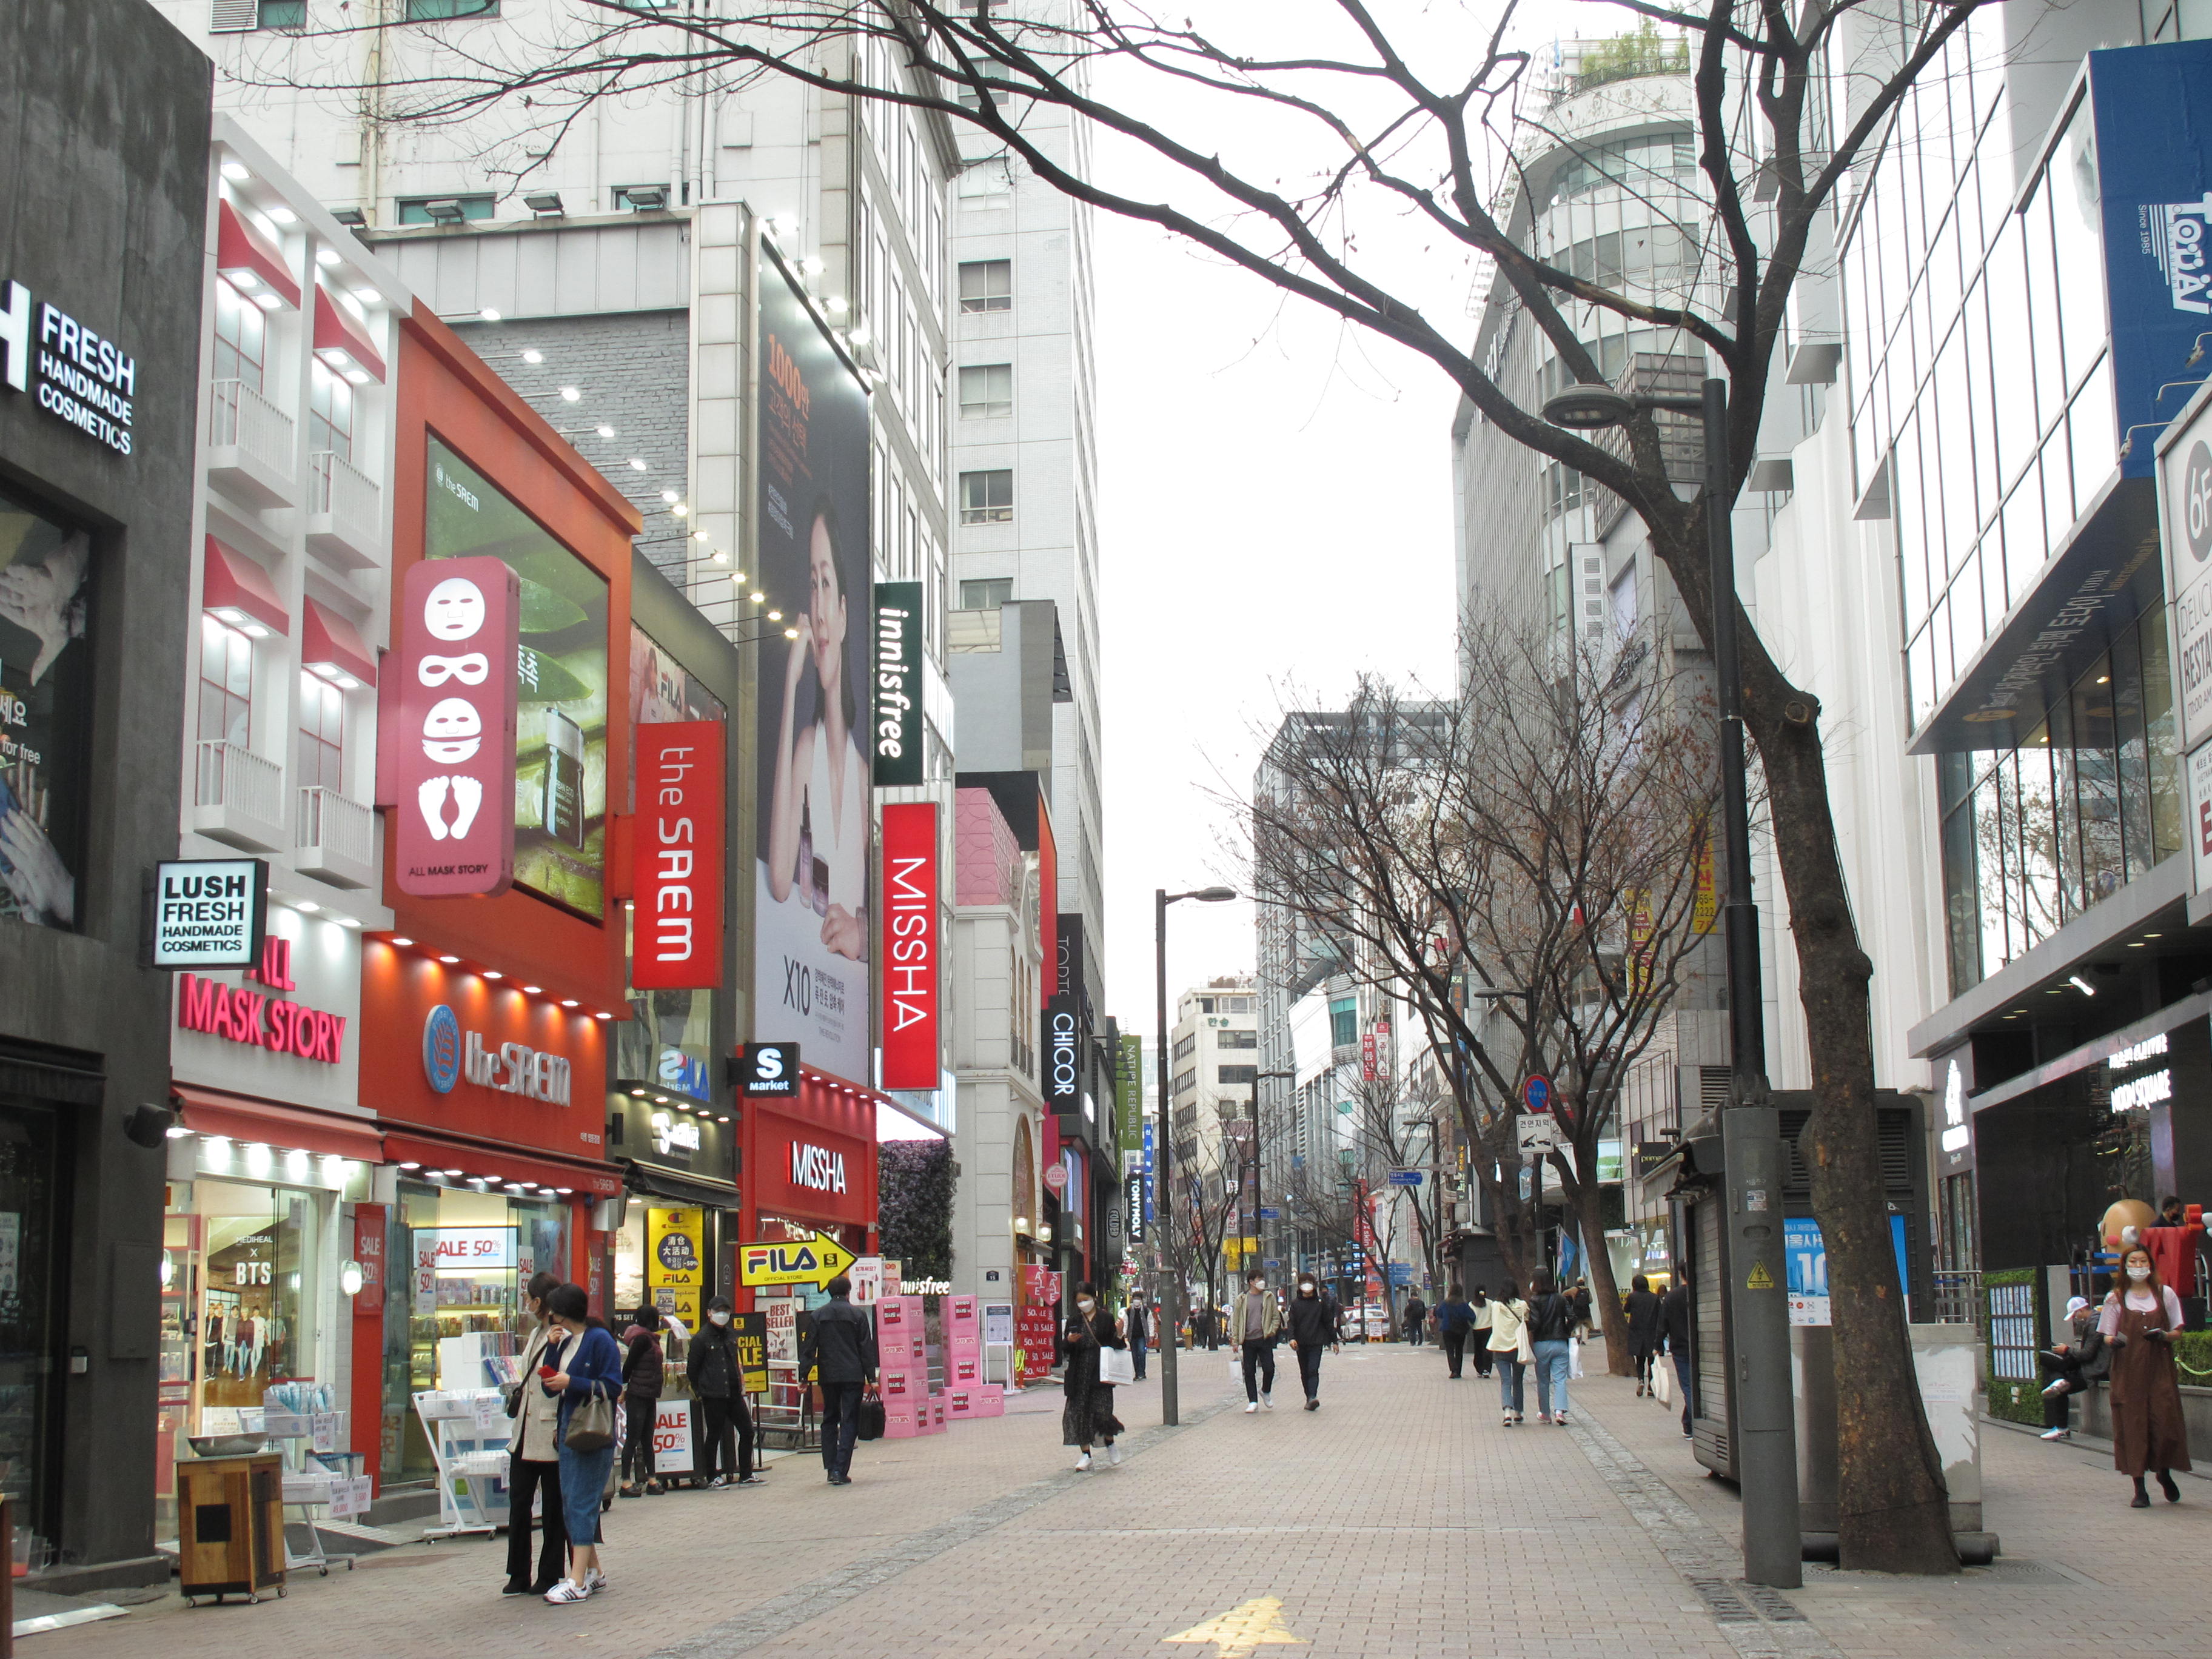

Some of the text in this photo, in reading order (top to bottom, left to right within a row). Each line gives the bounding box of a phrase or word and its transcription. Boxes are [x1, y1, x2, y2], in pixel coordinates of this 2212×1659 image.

[2138, 204, 2151, 255] Since 1985
[40, 302, 135, 397] FRESH
[40, 350, 133, 427] HANDMADE
[38, 382, 132, 455] COSMETICS
[456, 483, 480, 512] SAEM
[2189, 466, 2212, 540] 6F
[2077, 569, 2112, 593] TODAI
[2047, 594, 2115, 627] 토다이
[661, 672, 682, 714] FILA
[879, 608, 911, 759] innisfree
[2, 739, 41, 765] for free
[657, 747, 694, 962] the SAEM
[409, 864, 488, 877] ALL MASK STORY
[164, 875, 246, 899] LUSH
[163, 901, 244, 923] FRESH
[162, 924, 243, 937] HANDMADE
[893, 857, 928, 1032] MISSHA
[162, 940, 243, 952] COSMETICS
[783, 954, 811, 1016] X10
[179, 973, 266, 1046] MASK
[263, 997, 347, 1064] STORY
[756, 1048, 783, 1079] S
[1053, 1013, 1074, 1096] CHICOR
[465, 1030, 501, 1090] the
[498, 1041, 572, 1108] SAEM
[749, 1080, 789, 1091] Market
[1126, 1044, 1138, 1140] NATURE REPUBLIC
[2134, 1068, 2172, 1111] SQUARE
[652, 1113, 670, 1155] S
[1520, 1119, 1550, 1128] 견인지역
[792, 1140, 846, 1195] MISSHA
[1131, 1178, 1141, 1238] TONYMOLY
[236, 1236, 273, 1245] MEDIHEAL
[361, 1236, 380, 1256] SALE
[473, 1239, 501, 1256] 50%
[663, 1246, 689, 1256] 大活动
[236, 1262, 272, 1285] BTS
[419, 1251, 435, 1269] SALE
[520, 1258, 533, 1274] SALE
[748, 1245, 817, 1275] FILA
[663, 1274, 691, 1283] FILA
[900, 1276, 950, 1295] nnisfree
[1034, 1266, 1045, 1296] SALE
[1049, 1273, 1059, 1301] SALE
[766, 1315, 794, 1329] SELLER
[770, 1304, 790, 1316] BEST
[737, 1336, 762, 1348] CIAL
[737, 1347, 763, 1366] LE
[653, 1433, 685, 1454] 50%
